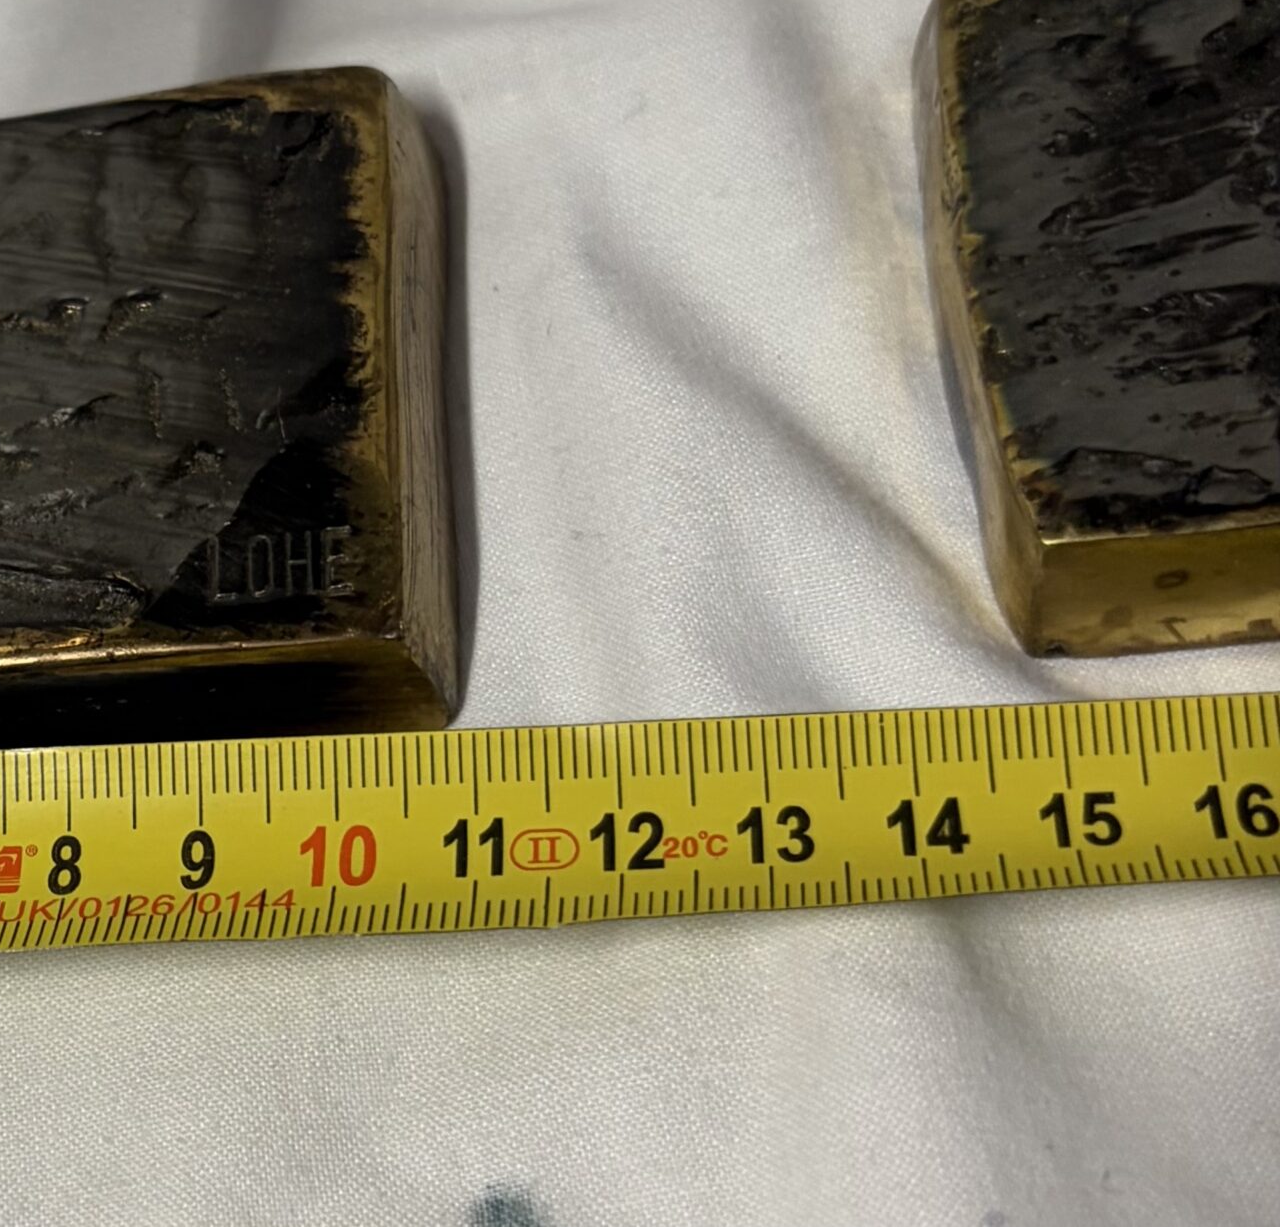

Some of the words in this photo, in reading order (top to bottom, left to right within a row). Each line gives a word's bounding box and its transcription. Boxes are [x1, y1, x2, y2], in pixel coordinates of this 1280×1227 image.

[207, 526, 355, 603] LOHE
[47, 835, 82, 896] 8
[180, 829, 215, 890] 9
[299, 825, 377, 887] 10
[442, 817, 505, 878] 11
[588, 811, 666, 871] 12
[663, 829, 729, 860] 20°C
[736, 804, 816, 865] 13
[886, 796, 970, 856] 14
[1039, 790, 1123, 849] 15
[1193, 783, 1280, 839] 16
